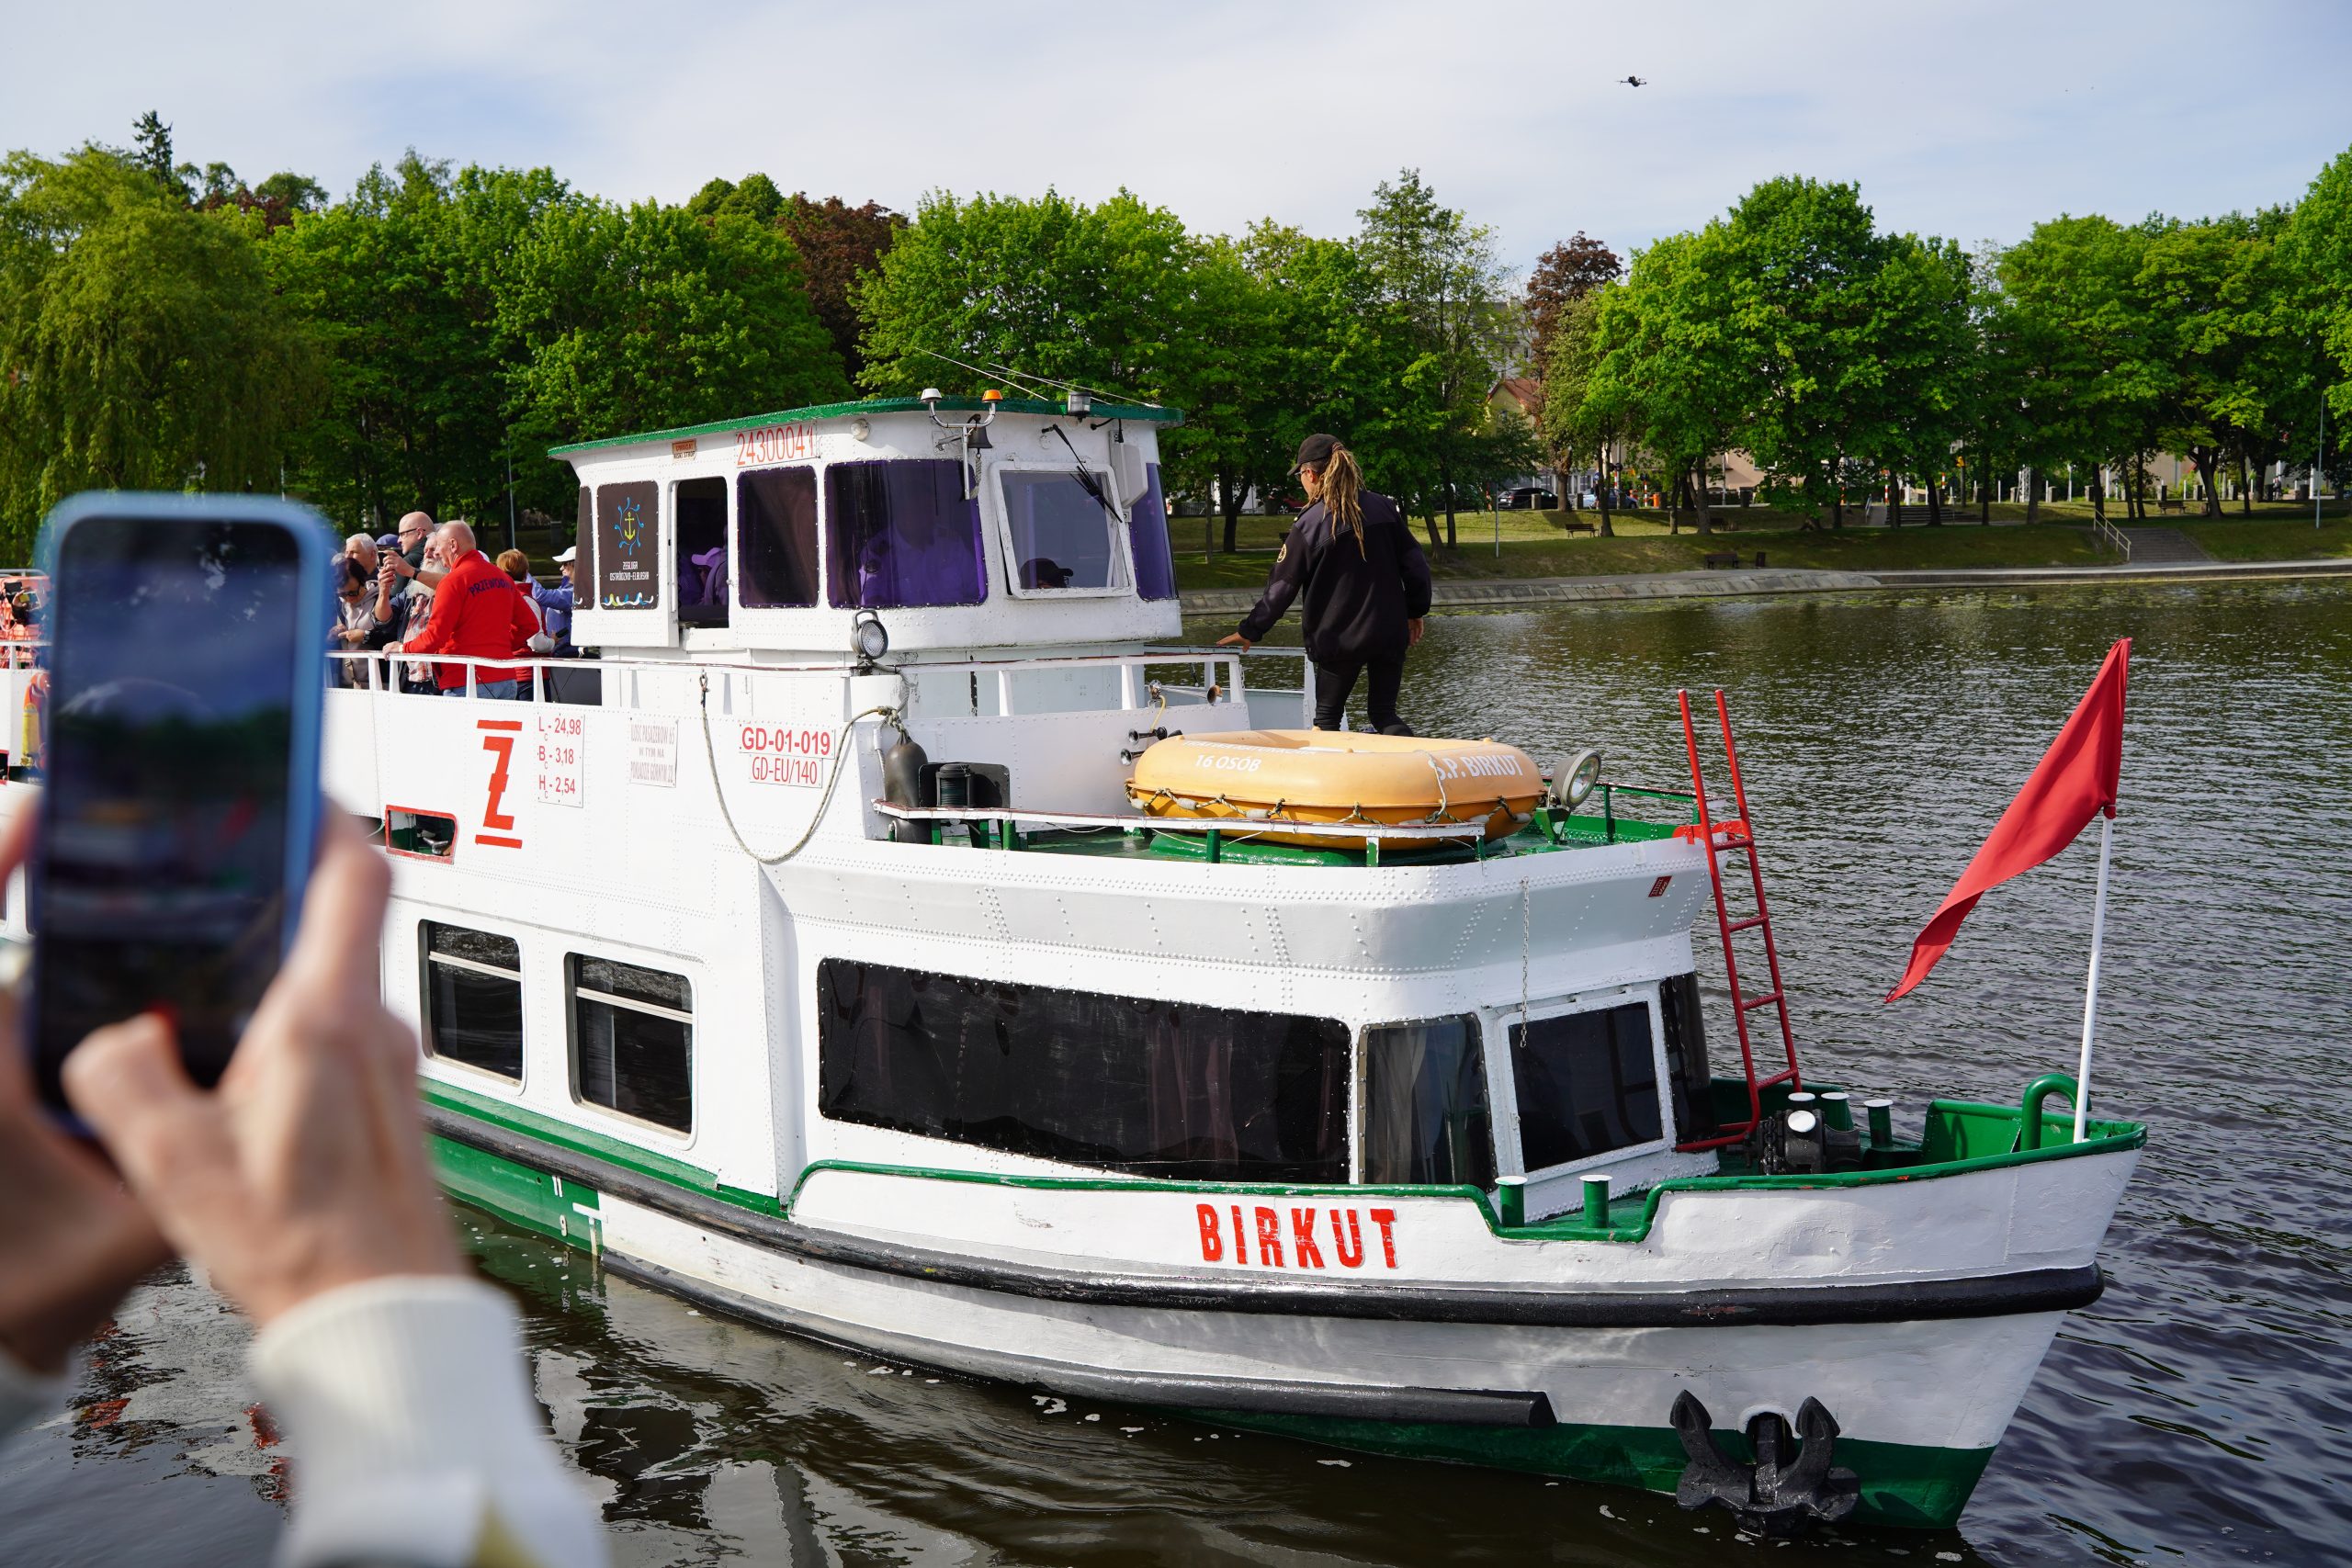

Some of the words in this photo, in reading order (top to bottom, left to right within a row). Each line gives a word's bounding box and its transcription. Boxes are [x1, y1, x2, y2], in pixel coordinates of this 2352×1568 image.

[737, 424, 814, 466] 24300041
[554, 717, 582, 738] 24,98
[741, 727, 831, 755] GD-01-019
[555, 747, 574, 766] 3,18
[1195, 754, 1215, 768] 16
[1216, 752, 1262, 773] OSÓB
[1459, 754, 1523, 777] BIRKUT
[752, 756, 818, 784] GD-EU/140
[555, 776, 576, 795] 2,54
[1195, 1203, 1398, 1269] BIRKUT
